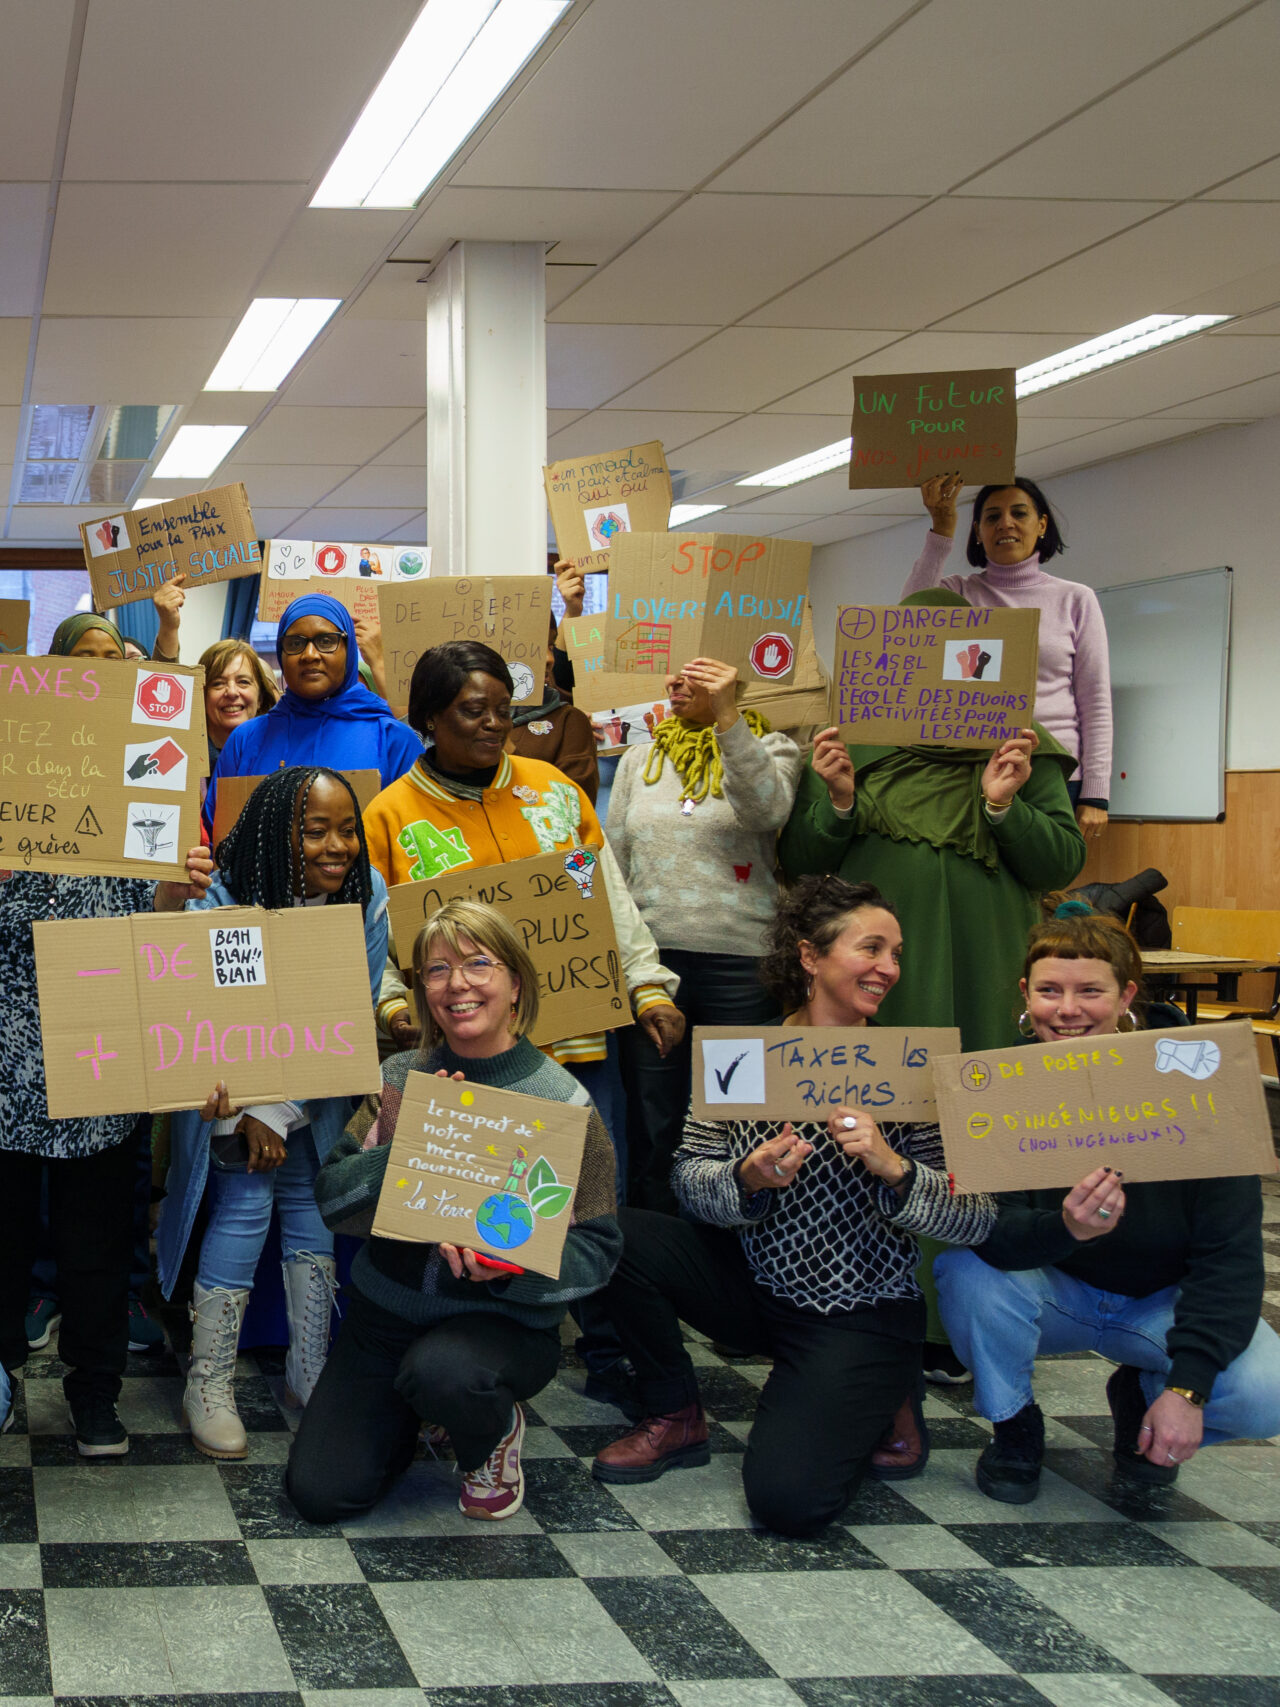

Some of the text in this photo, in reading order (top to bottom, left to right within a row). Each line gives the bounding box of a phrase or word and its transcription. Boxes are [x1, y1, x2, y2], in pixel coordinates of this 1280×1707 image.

[859, 392, 897, 414] UN
[907, 418, 967, 435] POUR
[854, 449, 897, 468] NOS
[138, 502, 220, 537] Ensemble
[136, 541, 164, 561] pour
[167, 534, 185, 547] la
[672, 541, 766, 578] STOP
[395, 602, 422, 623] DE
[882, 608, 994, 635] D'ARGENT
[453, 617, 517, 639] POUR
[841, 650, 928, 671] LES ASBL
[149, 703, 175, 714] STOP
[71, 725, 96, 746] de
[26, 754, 71, 777] dans
[81, 756, 107, 778] la
[45, 779, 90, 799] SÉCU
[17, 833, 81, 866] grèves
[528, 873, 568, 897] DE
[215, 929, 250, 946] BLAH
[513, 914, 590, 949] PLUS
[139, 943, 198, 982] DE
[214, 947, 263, 965] BLAH!!
[216, 966, 257, 985] BLAH
[767, 1037, 876, 1068] TAXER
[998, 1061, 1024, 1079] DE
[427, 1098, 534, 1138] Le respect de
[423, 1121, 472, 1143] notre
[1019, 1137, 1058, 1152] (NON
[402, 1180, 427, 1211] La
